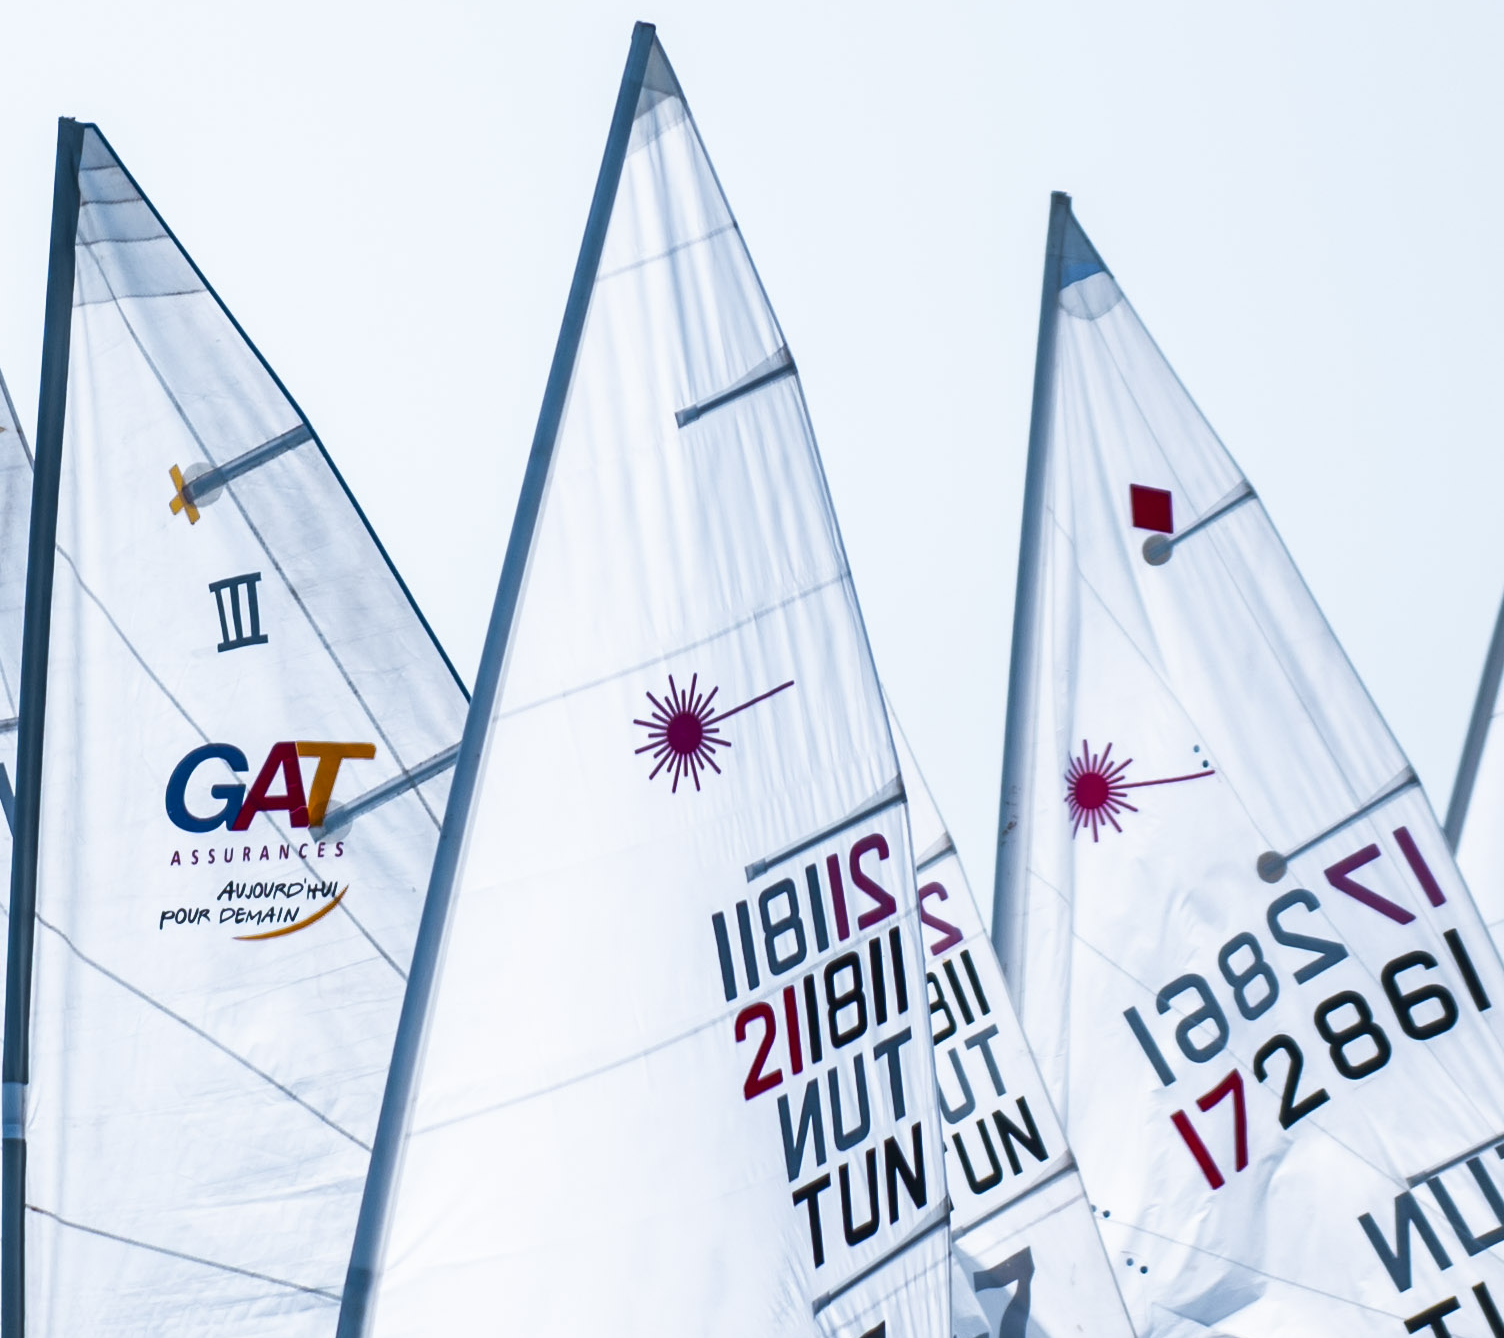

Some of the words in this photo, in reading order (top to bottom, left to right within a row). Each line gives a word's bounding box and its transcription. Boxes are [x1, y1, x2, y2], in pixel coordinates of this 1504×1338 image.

[165, 740, 377, 833] GAT
[170, 841, 345, 867] ASSURANCES
[216, 877, 339, 902] AUJOURD'HUI
[159, 907, 211, 930] POUR
[219, 907, 300, 926] DEMAIN
[734, 925, 909, 1101] 211811
[1171, 928, 1492, 1191] 172861
[792, 1120, 927, 1269] TUN
[945, 1095, 1049, 1203] UN
